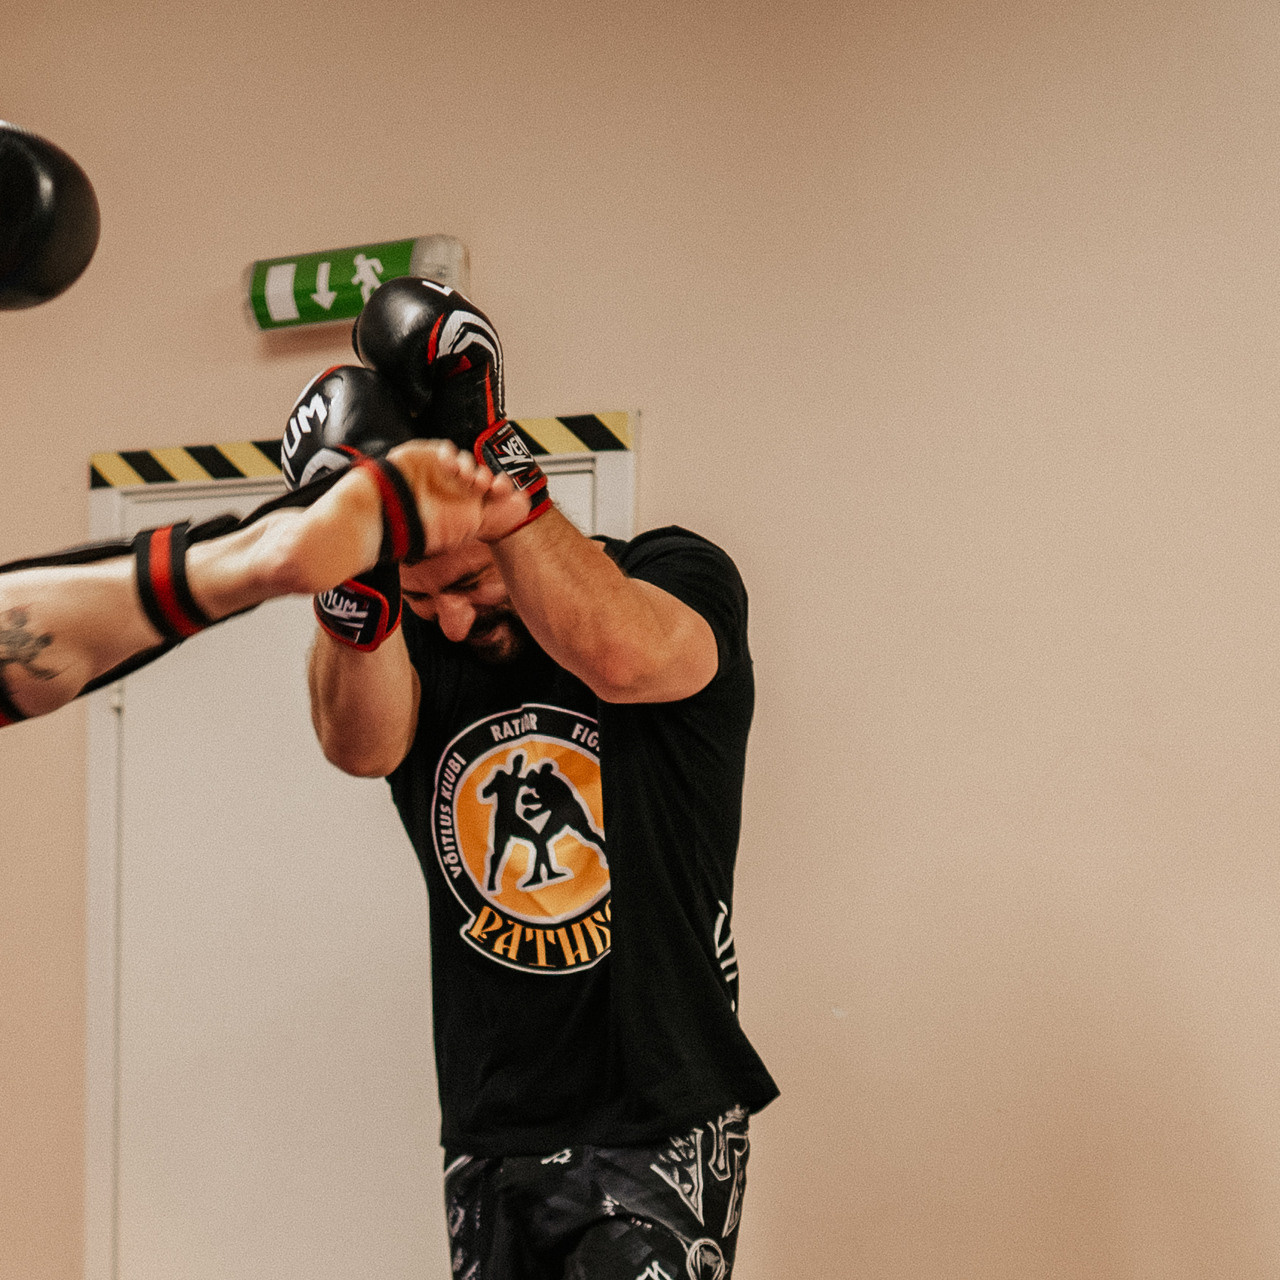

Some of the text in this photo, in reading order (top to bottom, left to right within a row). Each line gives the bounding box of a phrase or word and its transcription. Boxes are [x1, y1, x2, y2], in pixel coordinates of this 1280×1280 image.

[570, 722, 600, 752] FIG
[440, 751, 467, 801] KLUBI
[438, 804, 463, 880] VÕITLUS
